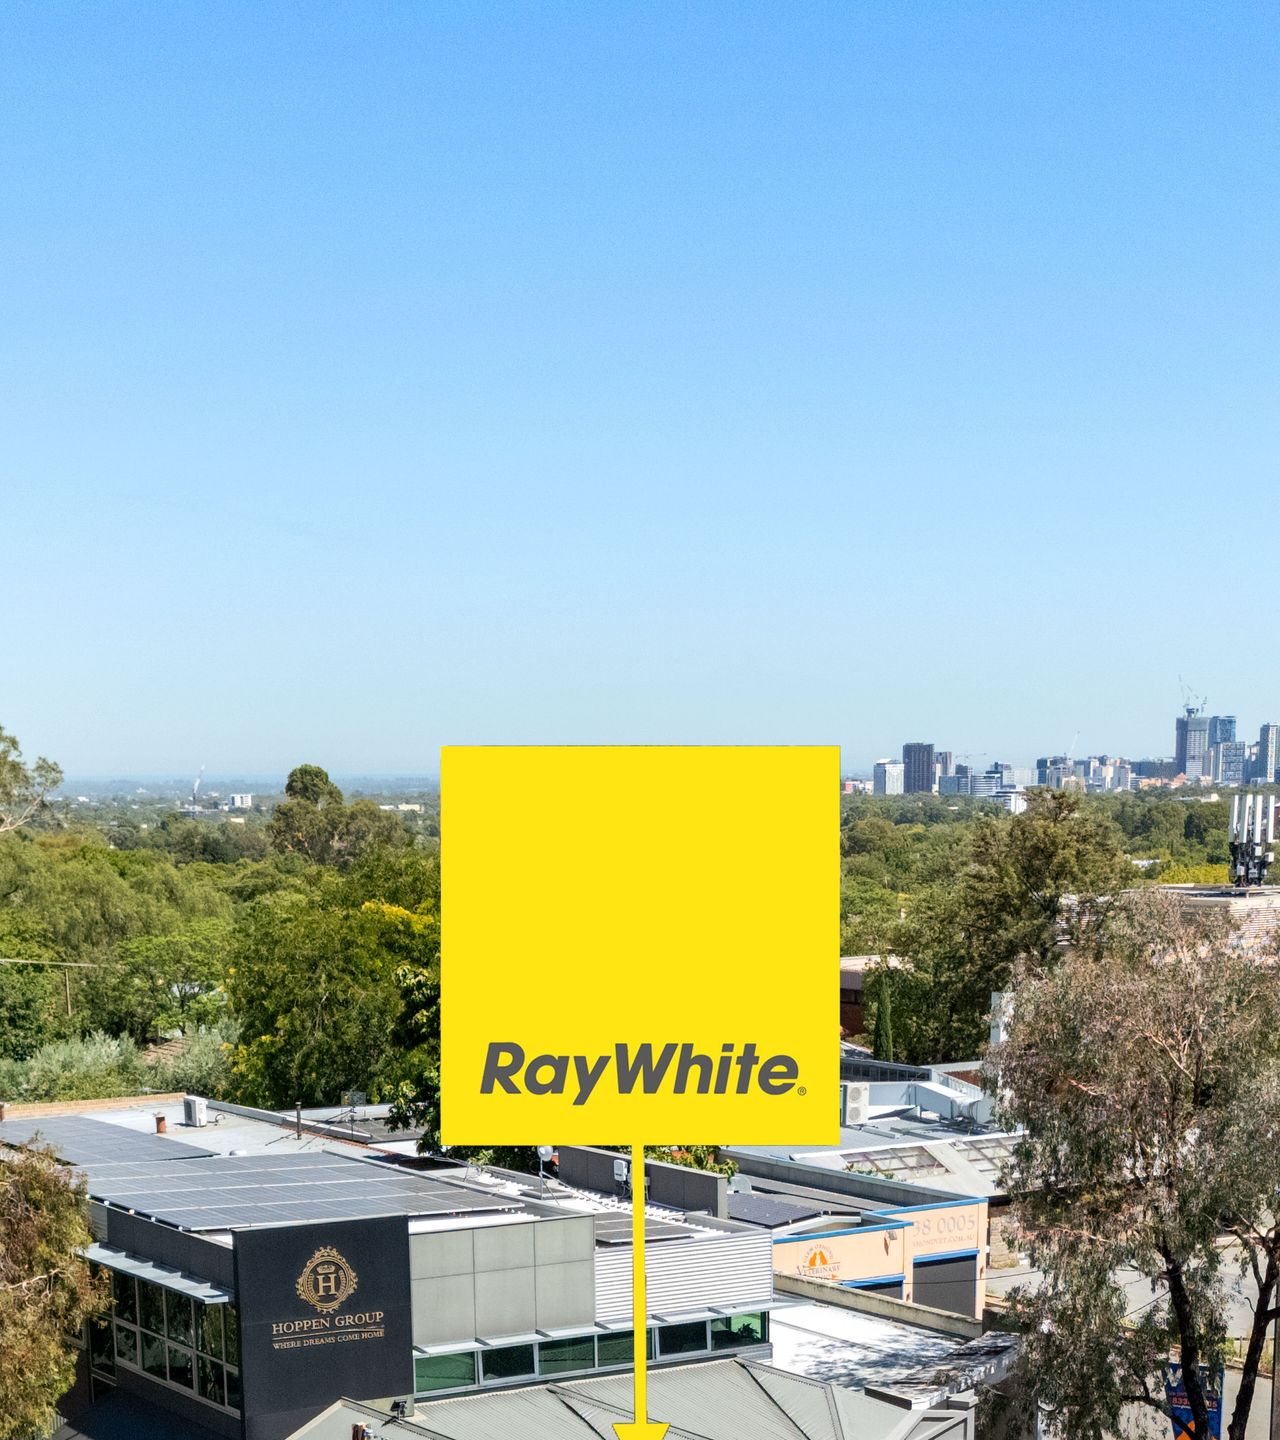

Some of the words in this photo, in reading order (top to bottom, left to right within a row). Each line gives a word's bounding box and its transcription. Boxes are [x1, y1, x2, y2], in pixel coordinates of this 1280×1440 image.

[936, 1214, 975, 1234] 0005
[315, 1273, 338, 1296] H
[272, 1317, 330, 1335] HOPPEN
[335, 1311, 384, 1327] GROUP
[272, 1340, 302, 1350] WHERE
[303, 1336, 336, 1347] DREAMS
[337, 1333, 360, 1343] COME
[361, 1330, 385, 1340] HOME
